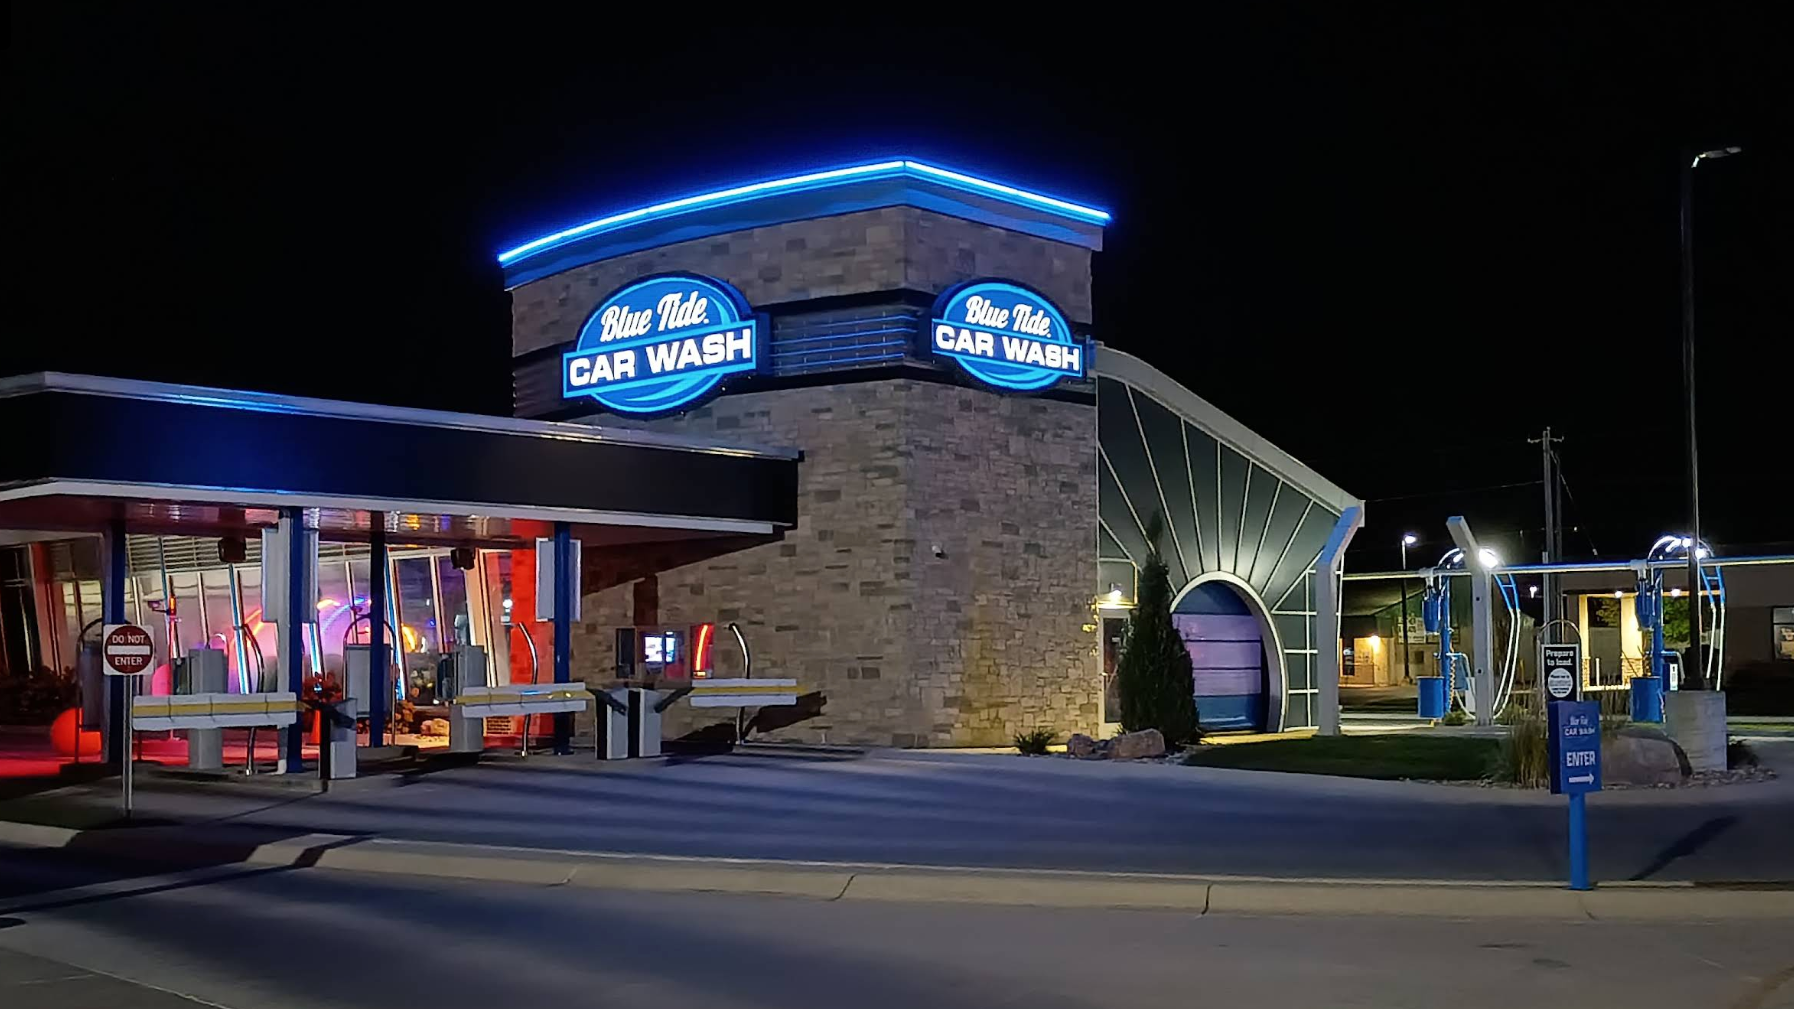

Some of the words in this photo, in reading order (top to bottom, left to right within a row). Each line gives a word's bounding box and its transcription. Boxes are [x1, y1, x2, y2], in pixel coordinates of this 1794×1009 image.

[965, 295, 1009, 328] Blue
[600, 305, 652, 342] Blue
[935, 324, 995, 357] CAR
[1002, 335, 1080, 371] WASH
[569, 350, 636, 386] CAR
[646, 328, 751, 374] WASH
[112, 634, 125, 644] DO
[127, 634, 146, 644] NOT
[1545, 650, 1574, 658] Prepare
[114, 656, 143, 666] ENTER
[1547, 658, 1555, 666] to
[1564, 727, 1578, 736] CAR
[1566, 750, 1596, 767] ENTER
